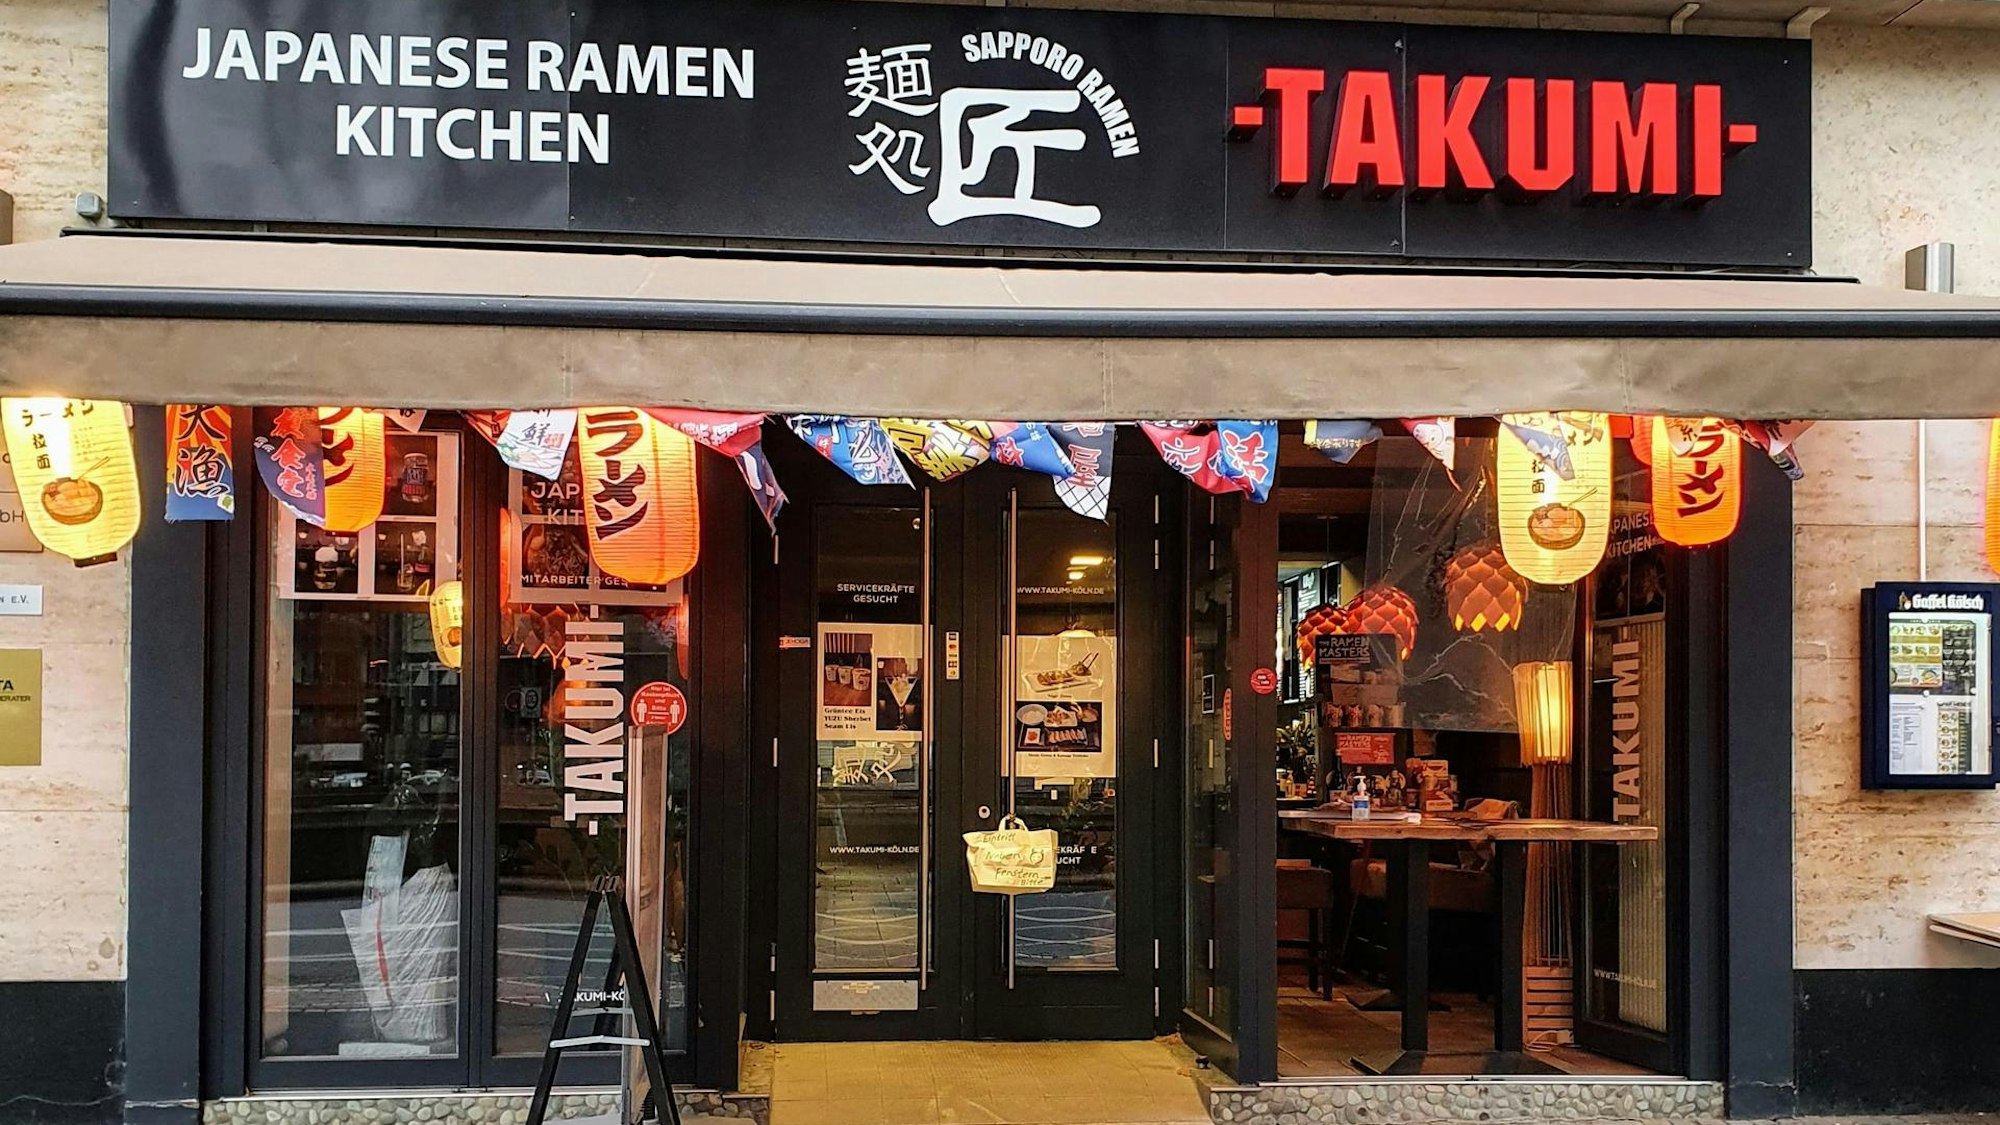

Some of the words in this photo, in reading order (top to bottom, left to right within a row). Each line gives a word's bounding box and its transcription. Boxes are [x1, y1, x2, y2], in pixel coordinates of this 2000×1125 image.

[182, 28, 509, 90] JAPANESE
[527, 41, 755, 99] RAMEN
[961, 31, 1084, 81] SAPPORO
[1076, 68, 1140, 158] RAMEN
[336, 104, 610, 164] KITCHEN
[927, 87, 1101, 228] 匠
[585, 410, 648, 541] ラーメン
[531, 482, 584, 500] JAP
[521, 574, 600, 585] MITARBEITER
[837, 583, 915, 594] SERVICEKRÄFTE
[853, 594, 899, 604] GESUCHT
[1331, 636, 1370, 647] RAMEN
[1319, 647, 1370, 657] MASTERS
